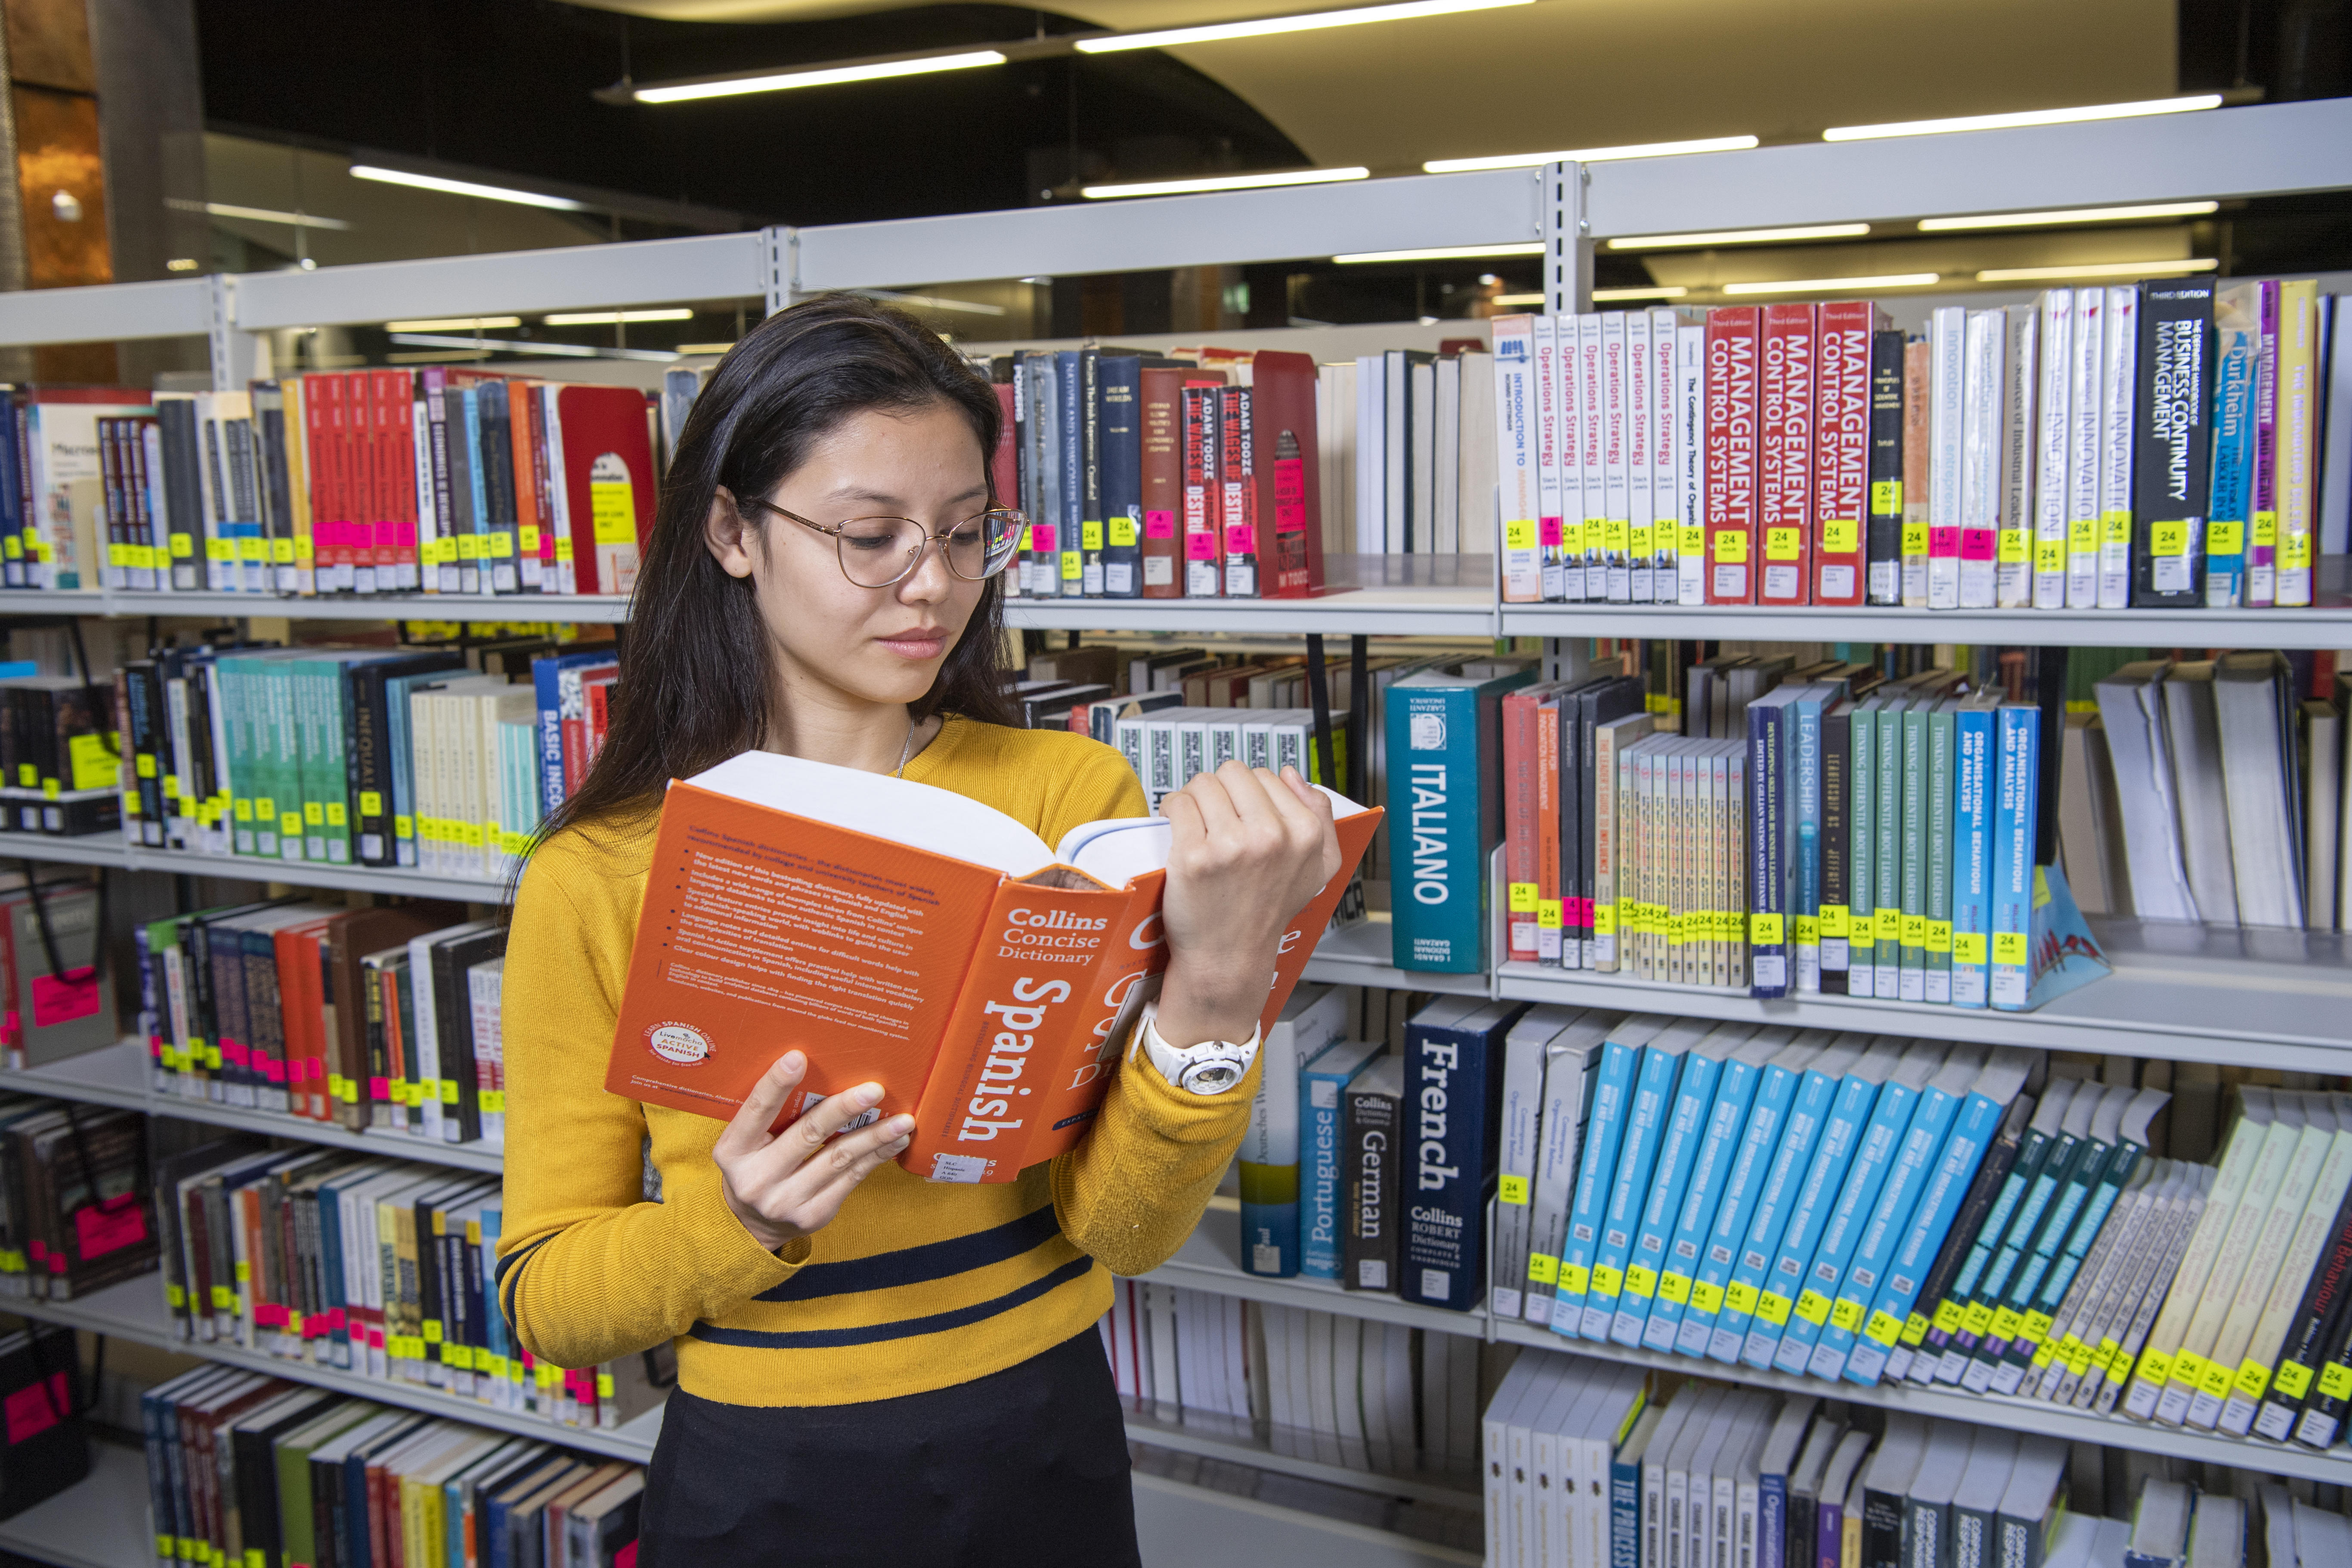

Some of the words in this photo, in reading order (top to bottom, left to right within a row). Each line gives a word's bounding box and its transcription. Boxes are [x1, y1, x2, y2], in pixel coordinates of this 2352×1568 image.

[2194, 319, 2204, 333] THE
[1065, 363, 1074, 407] NATIVES
[1538, 346, 1552, 412] Operations
[1562, 346, 1575, 412] Operations
[1584, 345, 1598, 411] Operations
[1607, 343, 1621, 409] Operations
[1632, 343, 1645, 411] Operations
[1658, 342, 1671, 410] Operations
[1711, 338, 1728, 432] CONTROL
[1766, 337, 1784, 431] CONTROL
[1822, 332, 1841, 427] CONTROL
[1947, 330, 1959, 410] innovation
[2153, 321, 2173, 441] MANAGEMENT
[2172, 320, 2192, 399] BUSINESS
[2259, 334, 2275, 424] MANAGEMENT
[1186, 396, 1203, 418] THE
[1203, 397, 1213, 434] ADAM
[1222, 392, 1240, 414] THE
[1240, 393, 1250, 430] ADAM
[1514, 373, 1525, 448] INTRODUCTION
[2223, 346, 2246, 436] Durkheim
[1068, 410, 1076, 433] AND
[1187, 419, 1203, 464] WAGES
[1223, 415, 1241, 462] WAGES
[1541, 415, 1554, 467] Strategy
[1564, 415, 1577, 467] Strategy
[1586, 414, 1599, 466] Strategy
[1608, 413, 1622, 465] Strategy
[1633, 414, 1646, 465] Strategy
[1658, 413, 1672, 465] Strategy
[1687, 396, 1696, 447] Contingency
[1729, 337, 1752, 524] MANAGEMENT
[1783, 334, 1808, 525] MANAGEMENT
[1838, 330, 1866, 521] MANAGEMENT
[1187, 466, 1202, 484] OF
[1203, 436, 1214, 479] TOOZE
[1225, 463, 1241, 481] OF
[1241, 433, 1252, 475] TOOZE
[1516, 452, 1525, 466] TO
[1687, 449, 1696, 478] Theory
[1819, 432, 1838, 520] SYSTEMS
[2012, 426, 2024, 484] Industrial
[2044, 413, 2064, 533] INNOVATION
[2168, 400, 2188, 501] CONTINUITY
[1688, 482, 1695, 491] of
[1710, 436, 1727, 523] SYSTEMS
[1764, 434, 1782, 523] SYSTEMS
[1119, 523, 1129, 531] 24
[1509, 528, 1520, 536] 24
[1588, 521, 1599, 529] 24
[1723, 535, 1735, 544] 24
[1775, 532, 1787, 541] 24
[2076, 524, 2089, 533] 24
[2161, 532, 2176, 541] 24
[544, 711, 561, 761] BASIC
[1857, 723, 1867, 768] THINKING
[1962, 732, 1972, 755] AND
[2005, 727, 2015, 751] AND
[1800, 714, 1814, 814] LEADERSHIP
[1961, 758, 1972, 813] ANALYSIS
[1972, 731, 1984, 829] ORGANISATIONAL
[2004, 755, 2015, 810] ANALYSIS
[2014, 727, 2028, 826] ORGANISATIONAL
[1411, 764, 1449, 905] ITALIANO
[1856, 829, 1866, 859] ABOUT
[695, 852, 713, 860] New
[715, 858, 742, 868] edition
[771, 872, 812, 888] bestselling
[814, 884, 853, 898] dictionary,
[856, 894, 872, 903] fully
[874, 900, 905, 911] updated
[1970, 832, 1982, 895] BEHAVIOUR
[2012, 830, 2024, 894] BEHAVIOUR
[708, 863, 729, 872] latest
[749, 875, 772, 884] words
[790, 885, 820, 896] phrases
[832, 896, 861, 907] Spanish
[880, 908, 908, 919] English
[1516, 887, 1526, 895] 24
[1823, 910, 1835, 919] 24
[1003, 928, 1101, 949] Concise
[1007, 908, 1108, 931] Collins
[1760, 923, 1772, 931] 24
[1856, 922, 1868, 931] 24
[2001, 936, 2014, 945] 24
[997, 946, 1095, 966] Dictionary
[720, 957, 745, 967] design
[747, 963, 767, 972] helps
[787, 973, 812, 985] finding
[848, 990, 886, 1002] translation
[888, 1001, 913, 1010] quickly
[643, 1023, 662, 1037] LEARN
[662, 1021, 701, 1033] SPANISH
[701, 1032, 716, 1052] ONLINE
[656, 1044, 700, 1058] SPANISH
[659, 1031, 703, 1046] Livemocha
[661, 1039, 698, 1051] ACTIVE
[958, 977, 1071, 1141] Spanish
[632, 1075, 678, 1089] Comprehensive
[679, 1086, 714, 1098] dictionaries.
[1354, 1097, 1392, 1111] Collins
[1256, 1107, 1268, 1164] Deutsches
[1418, 1039, 1459, 1191] French
[1311, 1111, 1338, 1243] Portuguese
[1362, 1130, 1386, 1239] German
[1506, 1183, 1517, 1191] 24
[1411, 1206, 1463, 1228] Collins
[1412, 1221, 1461, 1239] ROBERT
[2314, 1245, 2352, 1314] Behaviour
[2149, 1360, 2164, 1373] 24
[2282, 1368, 2298, 1380] 24
